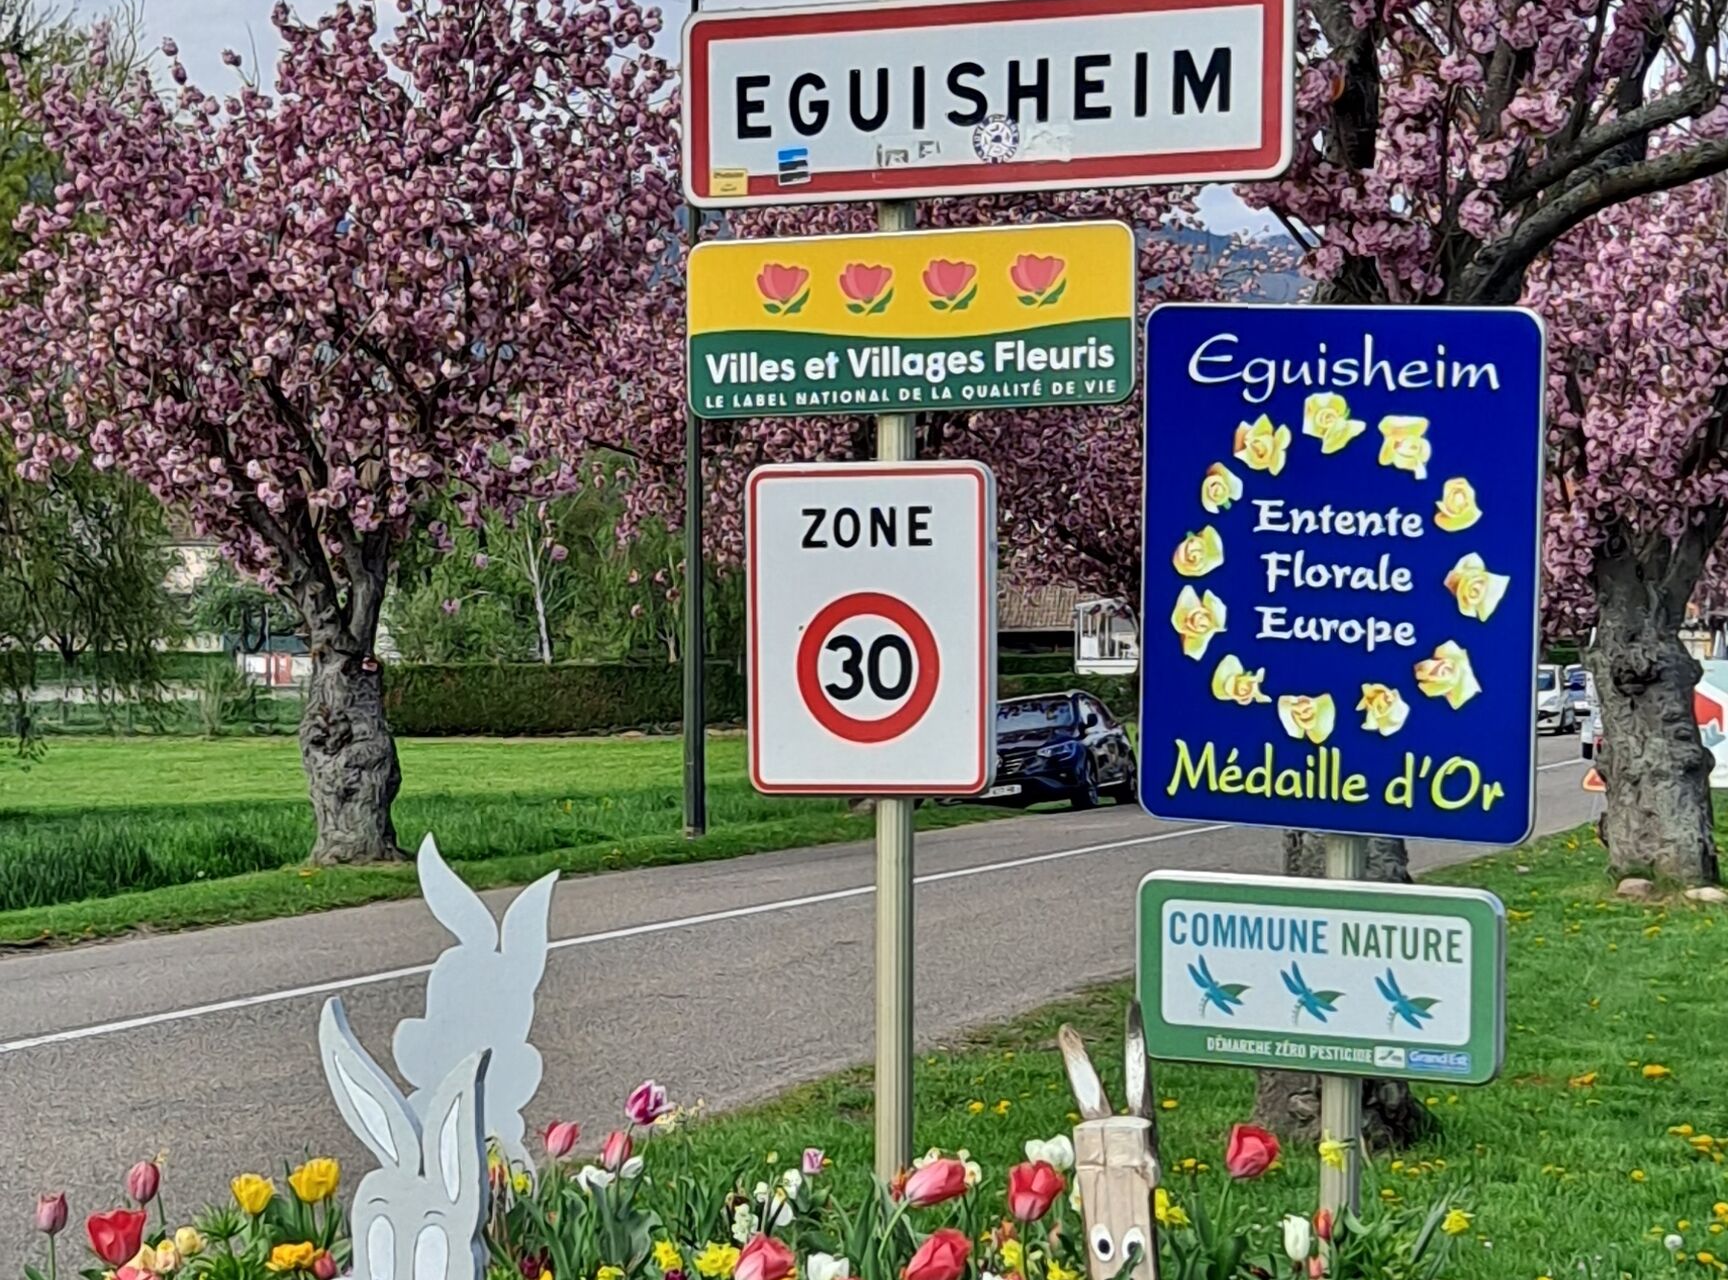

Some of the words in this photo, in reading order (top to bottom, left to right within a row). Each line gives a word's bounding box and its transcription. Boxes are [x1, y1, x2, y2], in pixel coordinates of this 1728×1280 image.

[736, 47, 1232, 139] EGUISHEIM
[705, 351, 796, 383] Villes
[804, 350, 839, 380] et
[847, 346, 985, 384] Villages
[994, 336, 1116, 373] Fleuris
[1187, 332, 1501, 404] Eguisheim
[705, 394, 725, 409] LE
[733, 391, 788, 408] LABEL
[796, 388, 890, 406] NATIONAL
[899, 386, 922, 402] DE
[931, 385, 953, 400] LA
[962, 378, 1042, 399] QUALITÉ
[1052, 381, 1076, 396] DE
[1084, 378, 1117, 395] VIE
[801, 505, 934, 549] ZONE
[1251, 498, 1425, 539] Entente
[1260, 550, 1414, 594] Florale
[1254, 605, 1417, 653] Europe
[825, 634, 914, 701] 30
[1166, 737, 1370, 804] Médaille
[1384, 751, 1505, 812] d'Or
[1168, 910, 1329, 955] COMMUNE
[1341, 921, 1464, 964] NATURE
[1206, 1035, 1273, 1056] DÉMARCHE
[1275, 1039, 1307, 1059] ZÉRO
[1309, 1044, 1373, 1064] PESTICIDE
